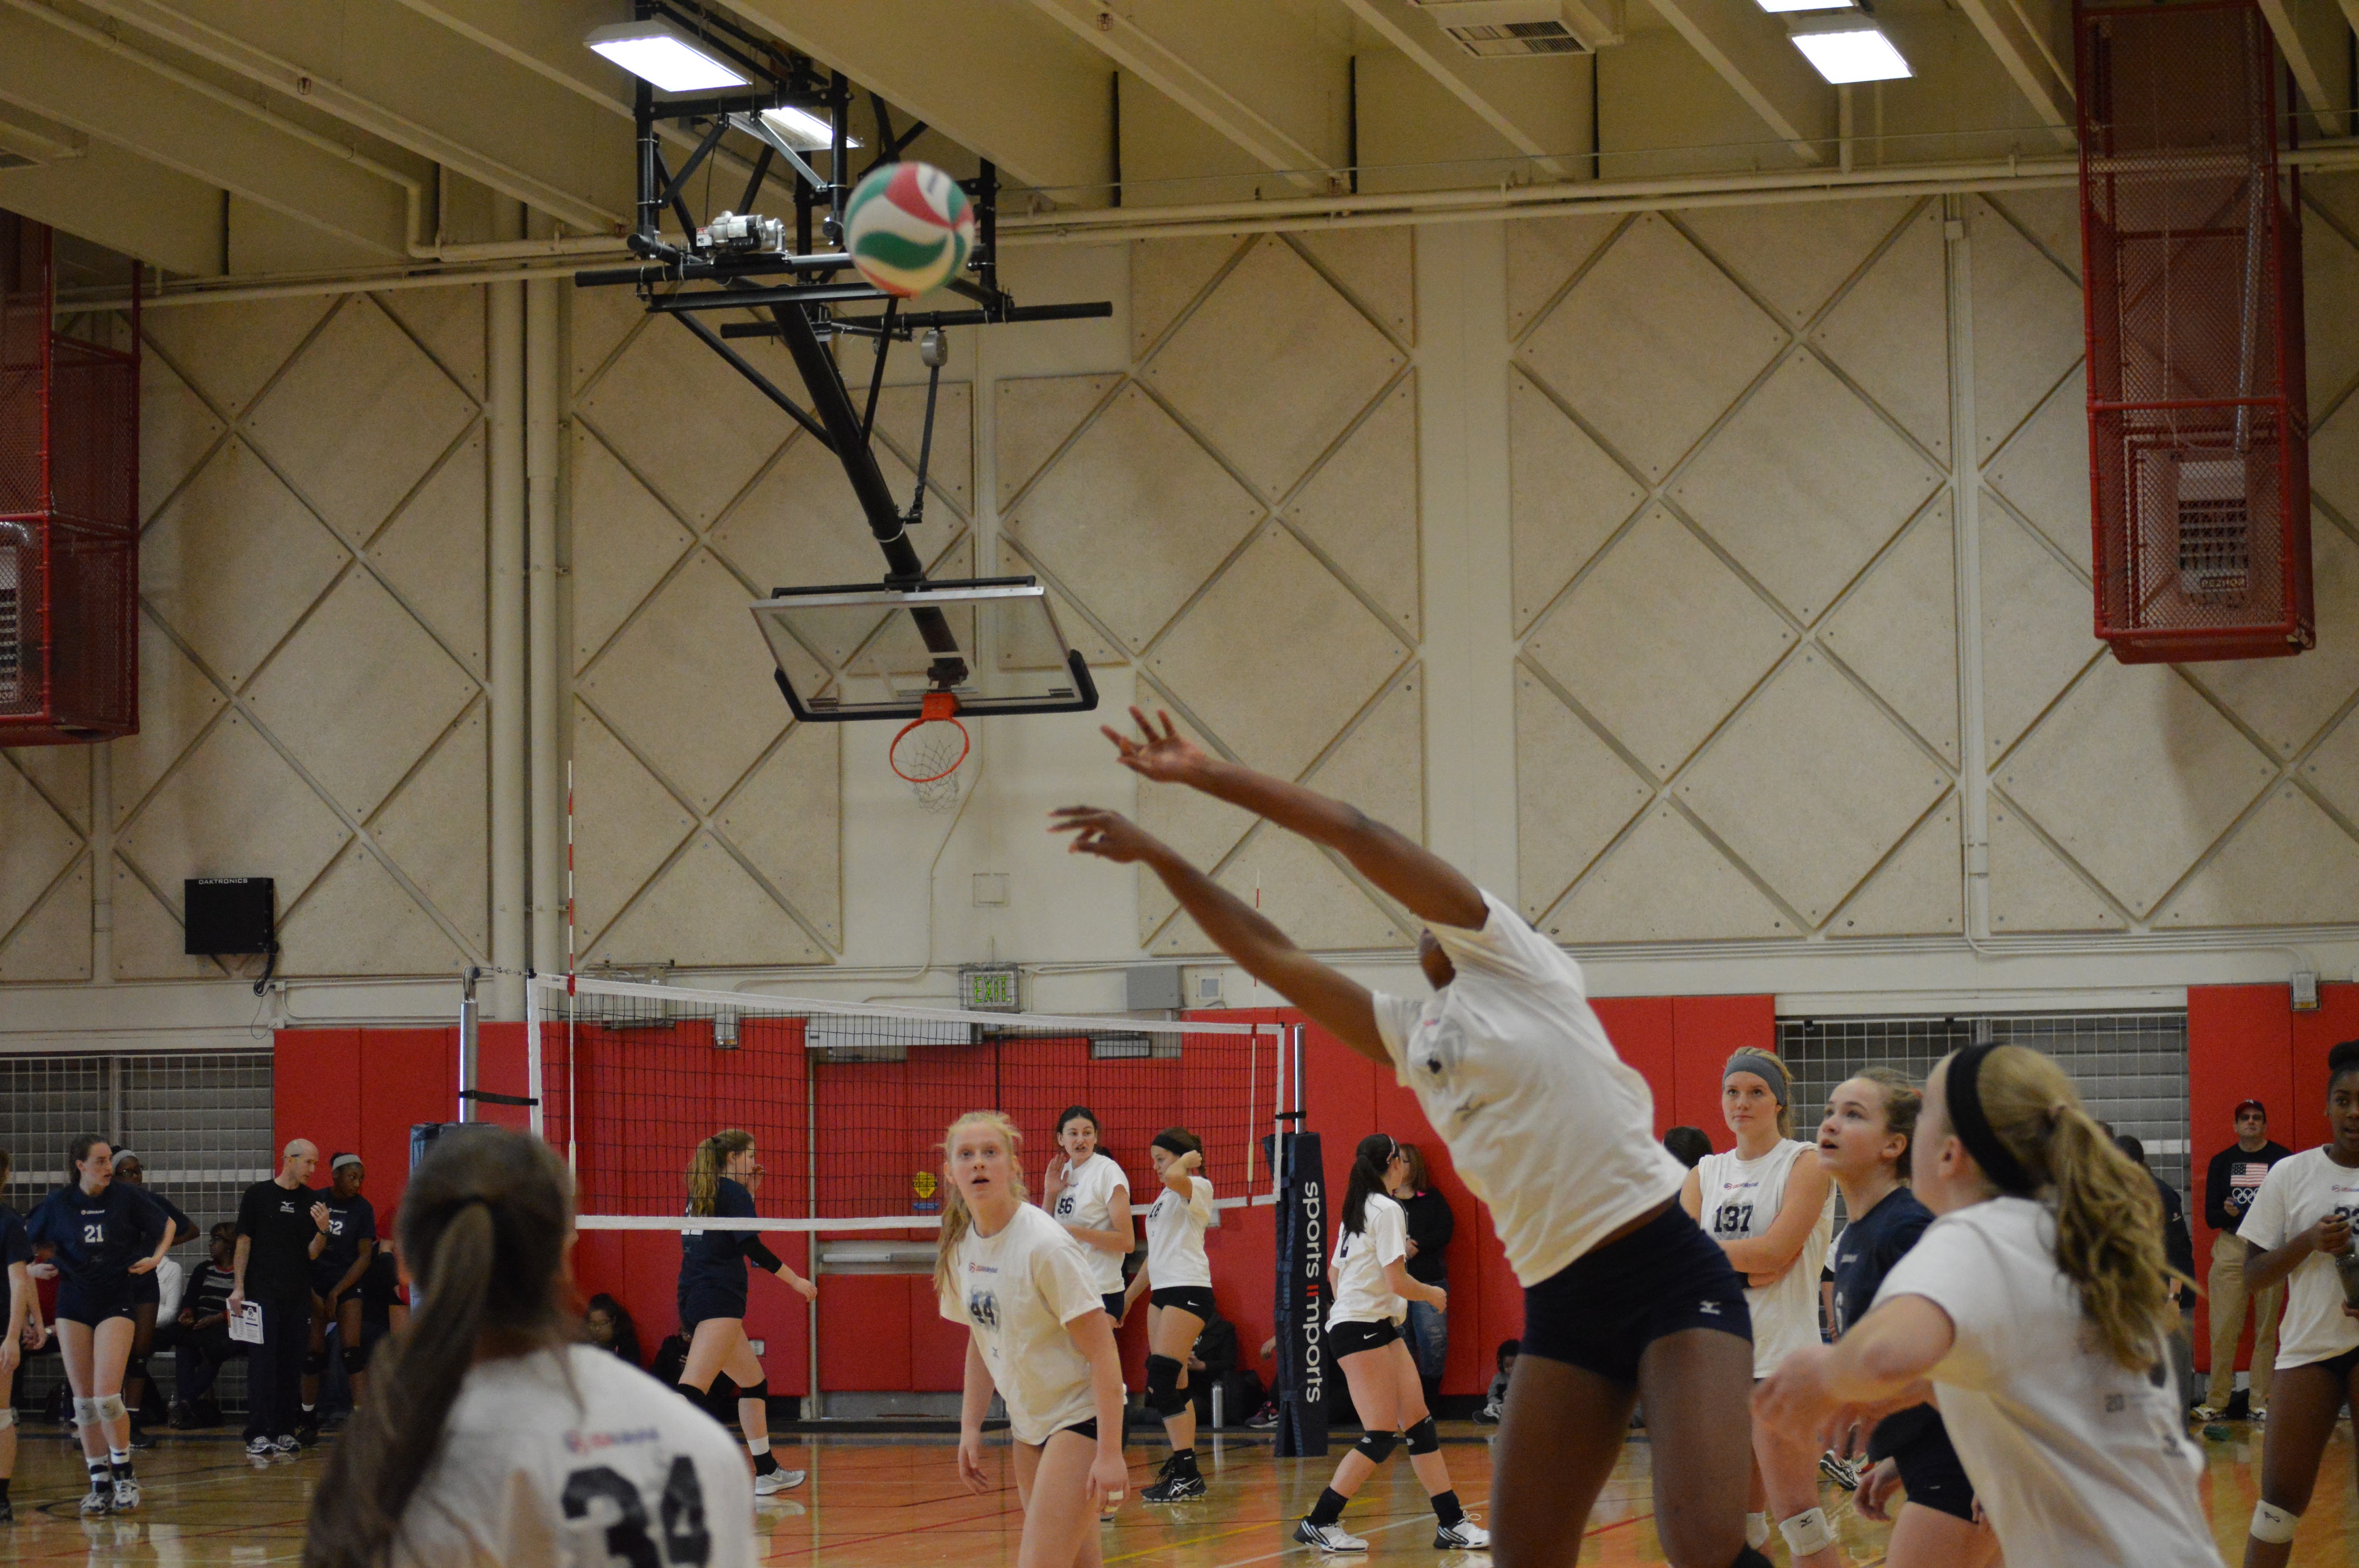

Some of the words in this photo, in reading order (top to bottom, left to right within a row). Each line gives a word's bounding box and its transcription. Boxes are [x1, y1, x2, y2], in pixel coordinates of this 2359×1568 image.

[974, 976, 1007, 1003] EXIT
[1057, 1197, 1074, 1215] 56
[1149, 1203, 1163, 1218] 18
[1714, 1205, 1753, 1232] 137
[84, 1224, 104, 1243] 21
[1303, 1181, 1322, 1278] sports
[971, 1294, 996, 1326] 44
